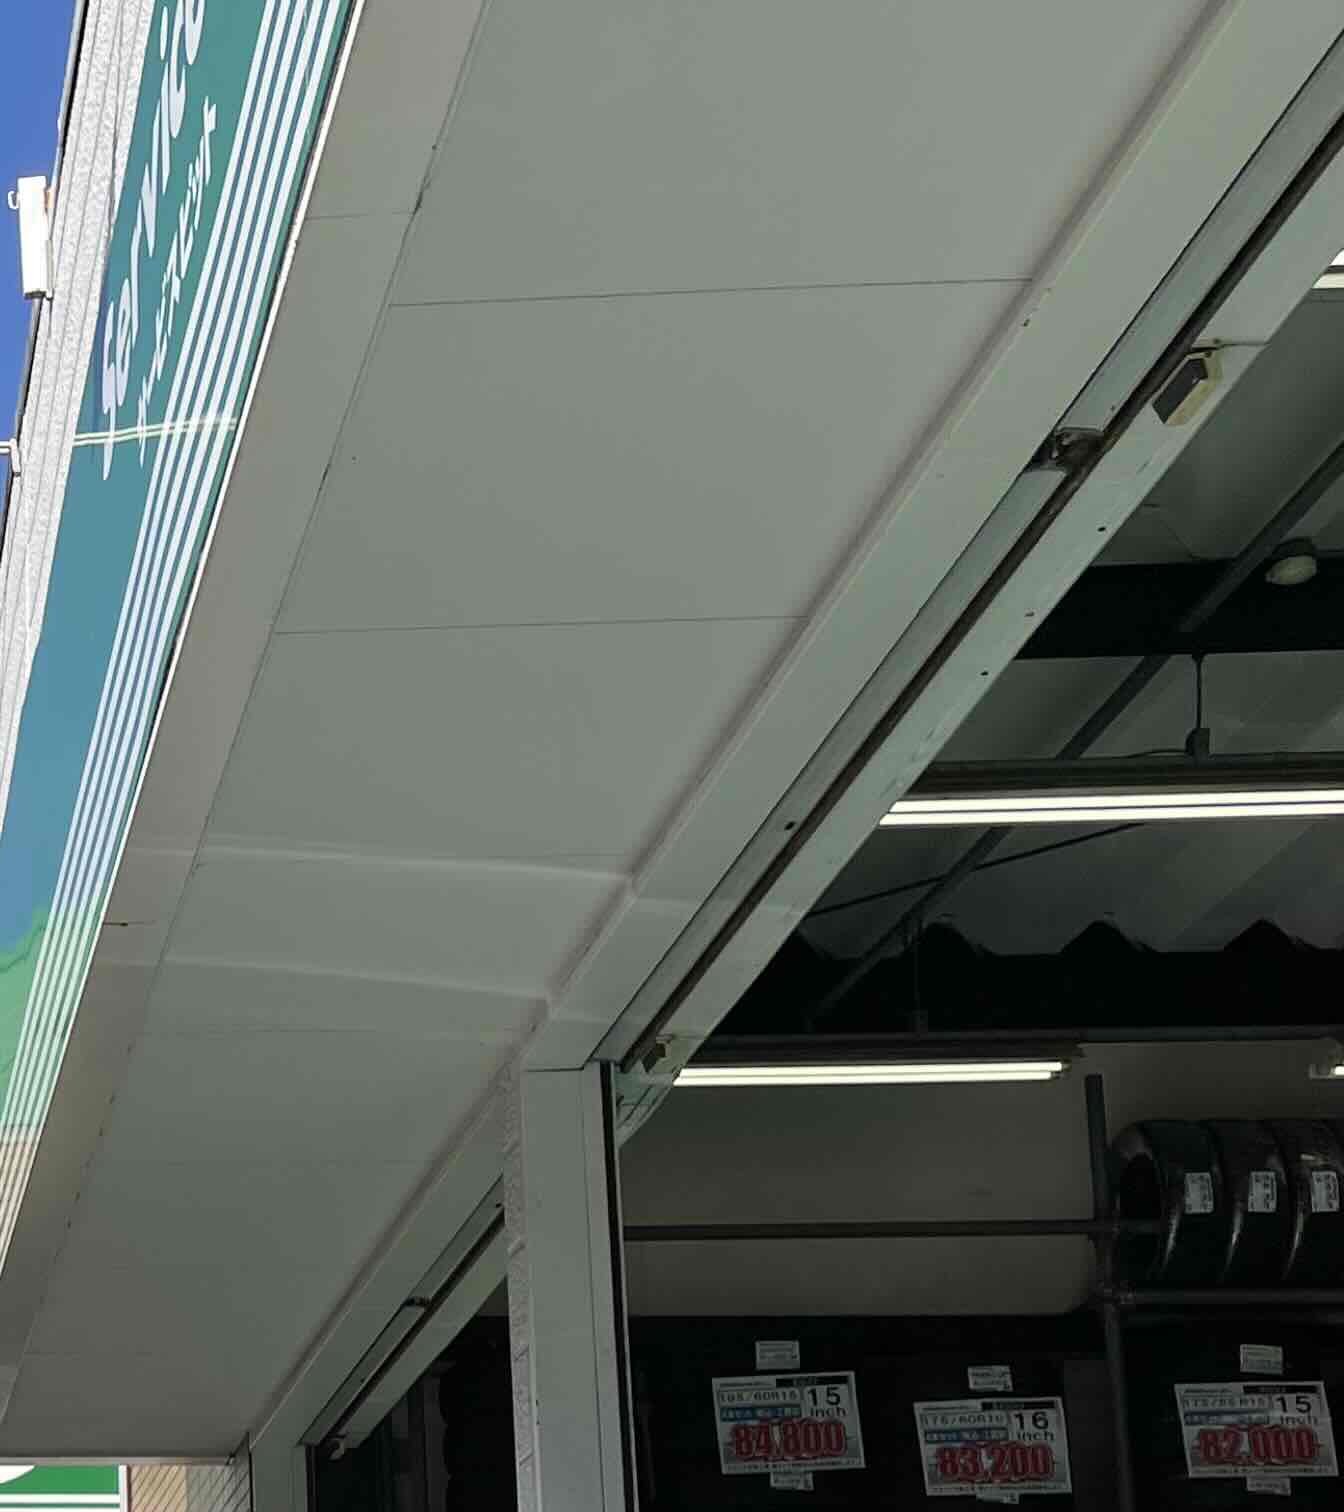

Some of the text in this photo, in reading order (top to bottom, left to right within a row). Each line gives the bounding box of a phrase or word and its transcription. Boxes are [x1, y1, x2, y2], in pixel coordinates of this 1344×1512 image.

[807, 1386, 841, 1406] 15
[1276, 1395, 1312, 1413] 15
[1014, 1411, 1050, 1430] 16
